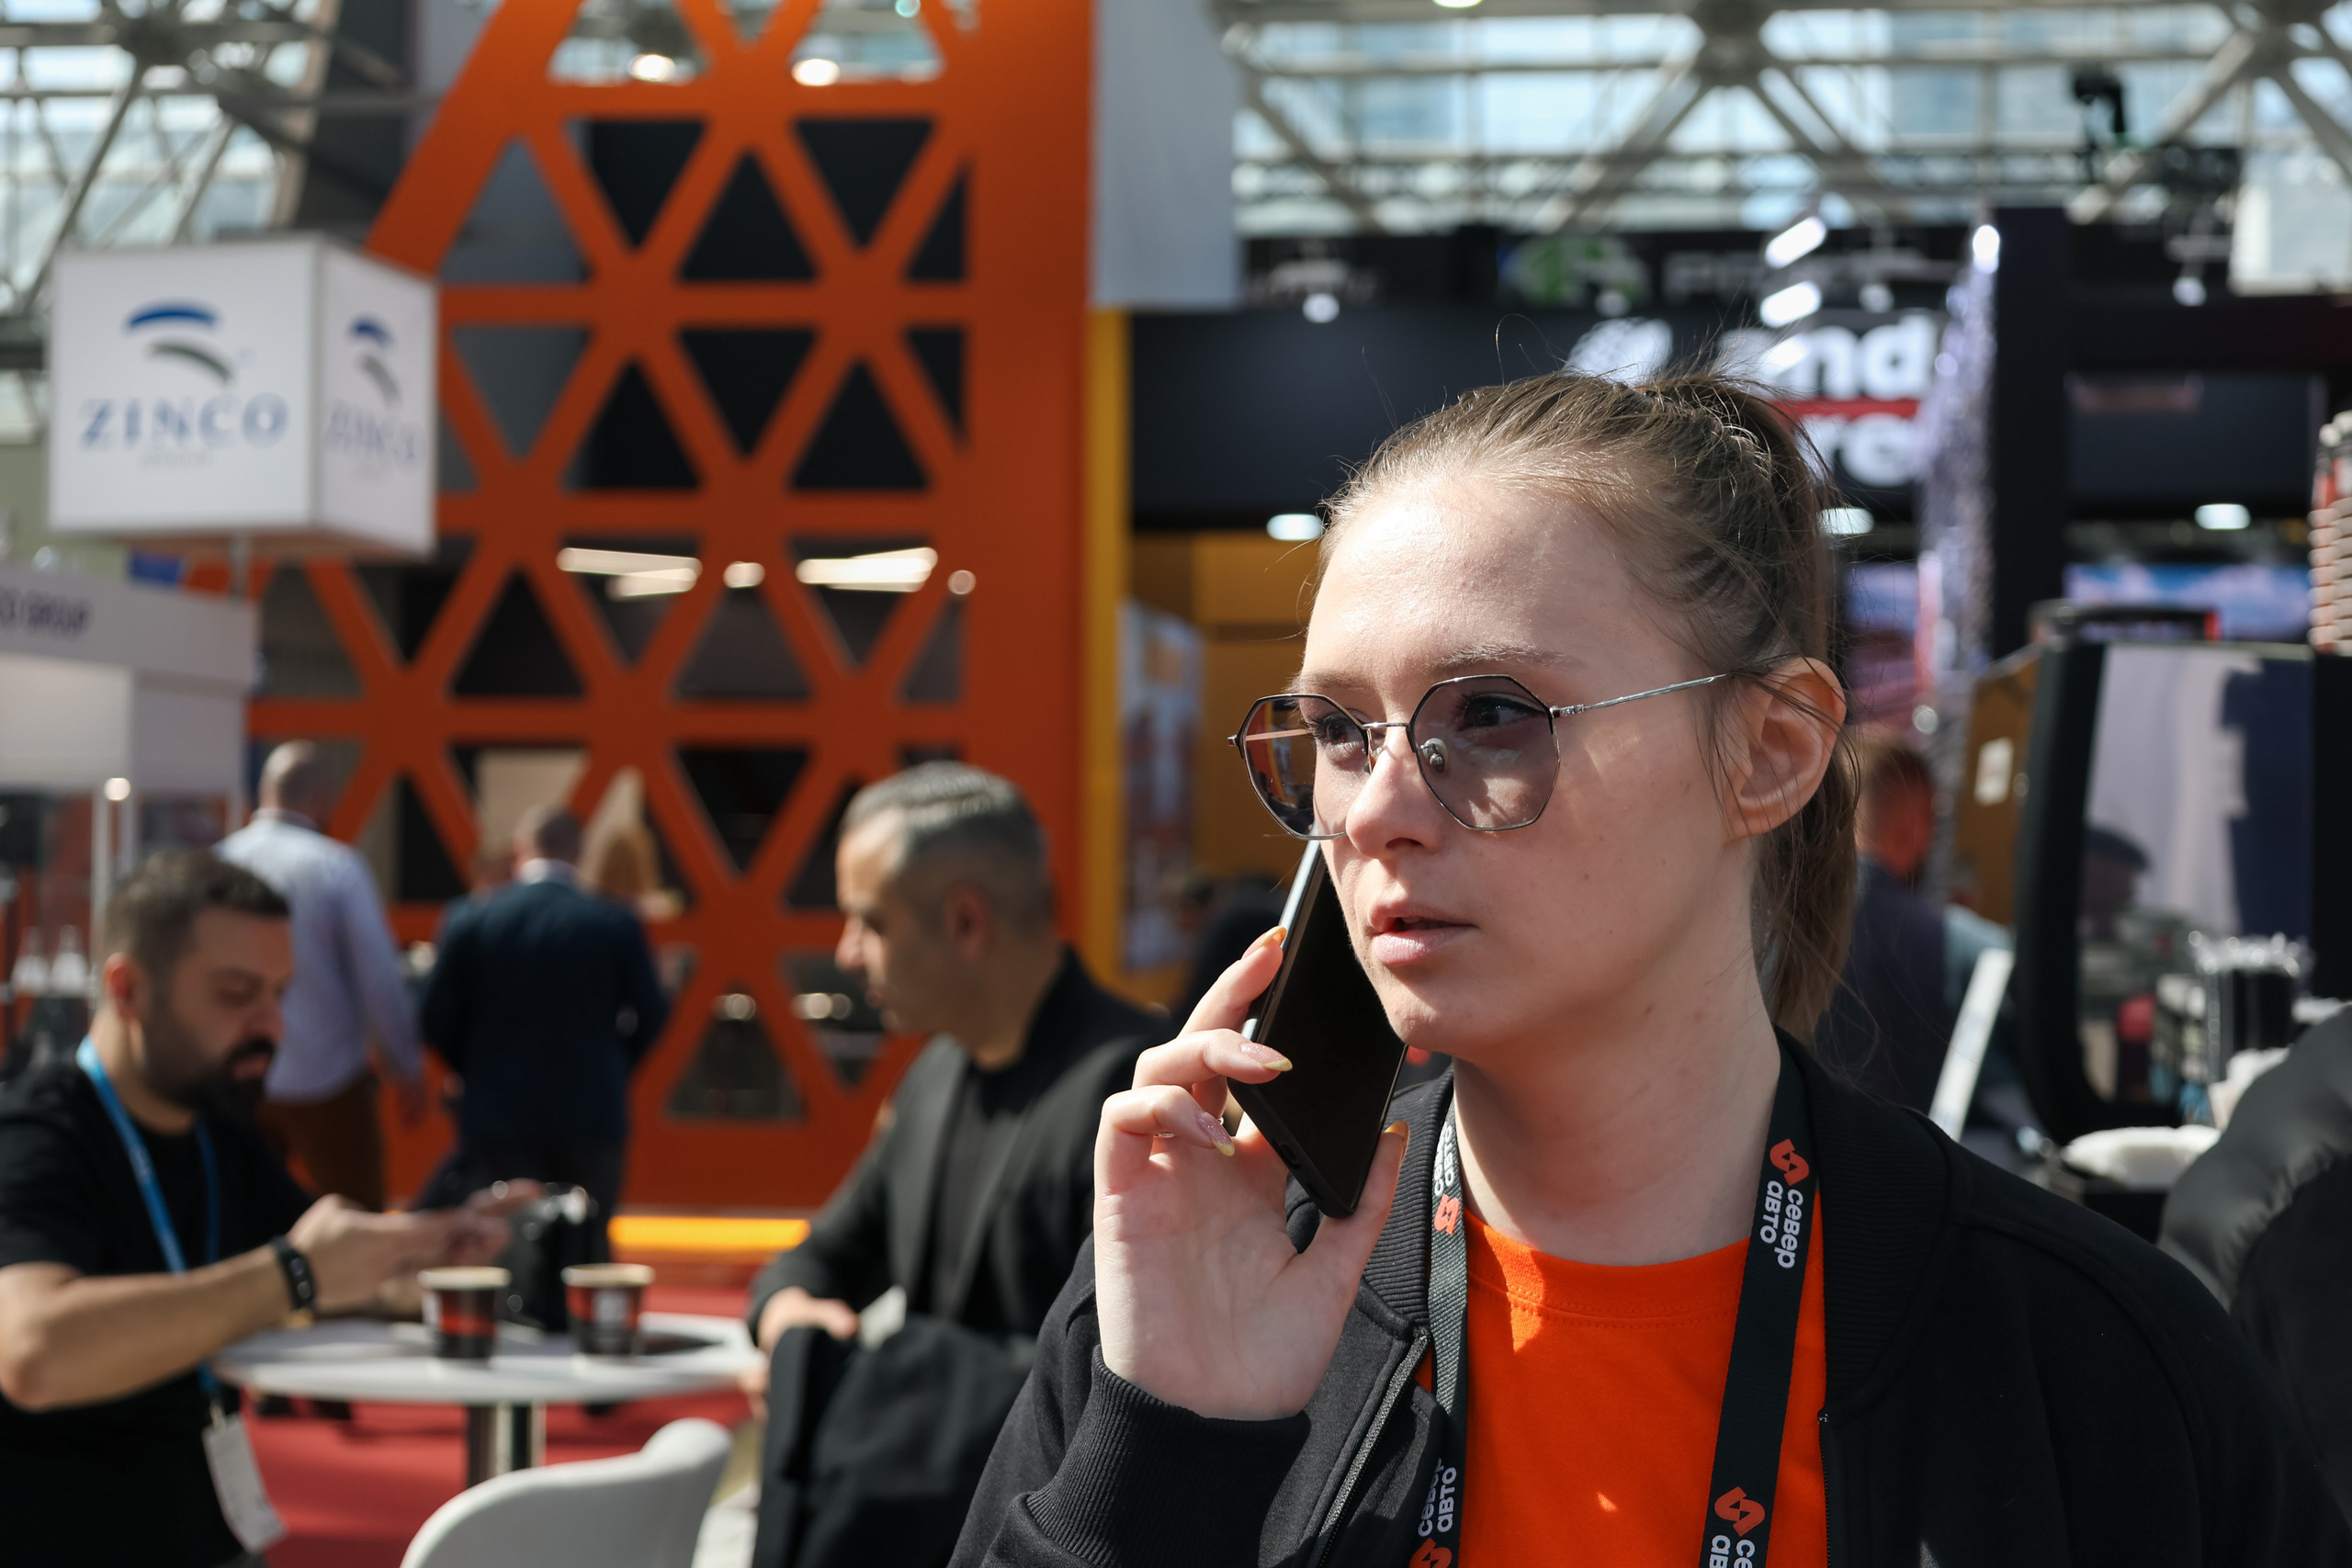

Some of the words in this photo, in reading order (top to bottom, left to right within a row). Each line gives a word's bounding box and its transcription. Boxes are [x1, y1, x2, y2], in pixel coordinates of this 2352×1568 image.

[79, 393, 289, 451] ZINCO
[1759, 1180, 1783, 1244] авто
[1774, 1189, 1804, 1269] север
[1437, 1467, 1457, 1532] авто
